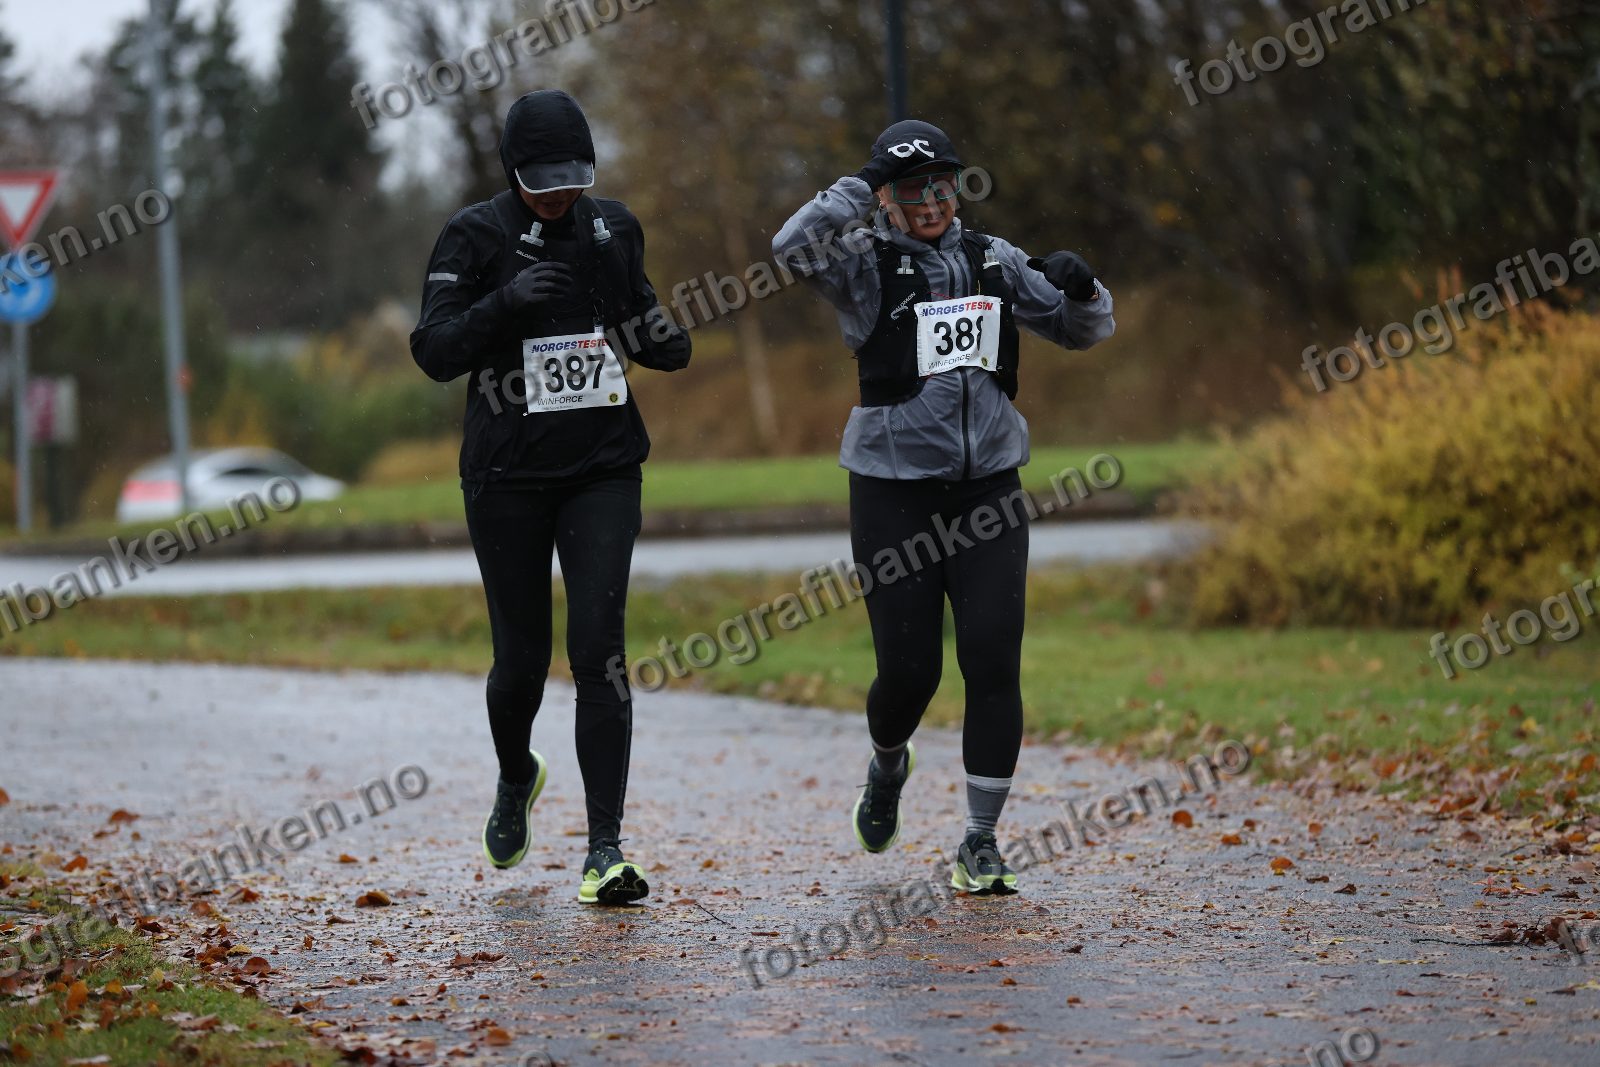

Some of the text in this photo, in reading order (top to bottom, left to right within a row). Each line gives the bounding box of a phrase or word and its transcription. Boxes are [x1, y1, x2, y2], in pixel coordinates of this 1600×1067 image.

[928, 353, 971, 369] WINFORCE
[544, 353, 605, 393] 387
[537, 395, 584, 406] WINFORCE
